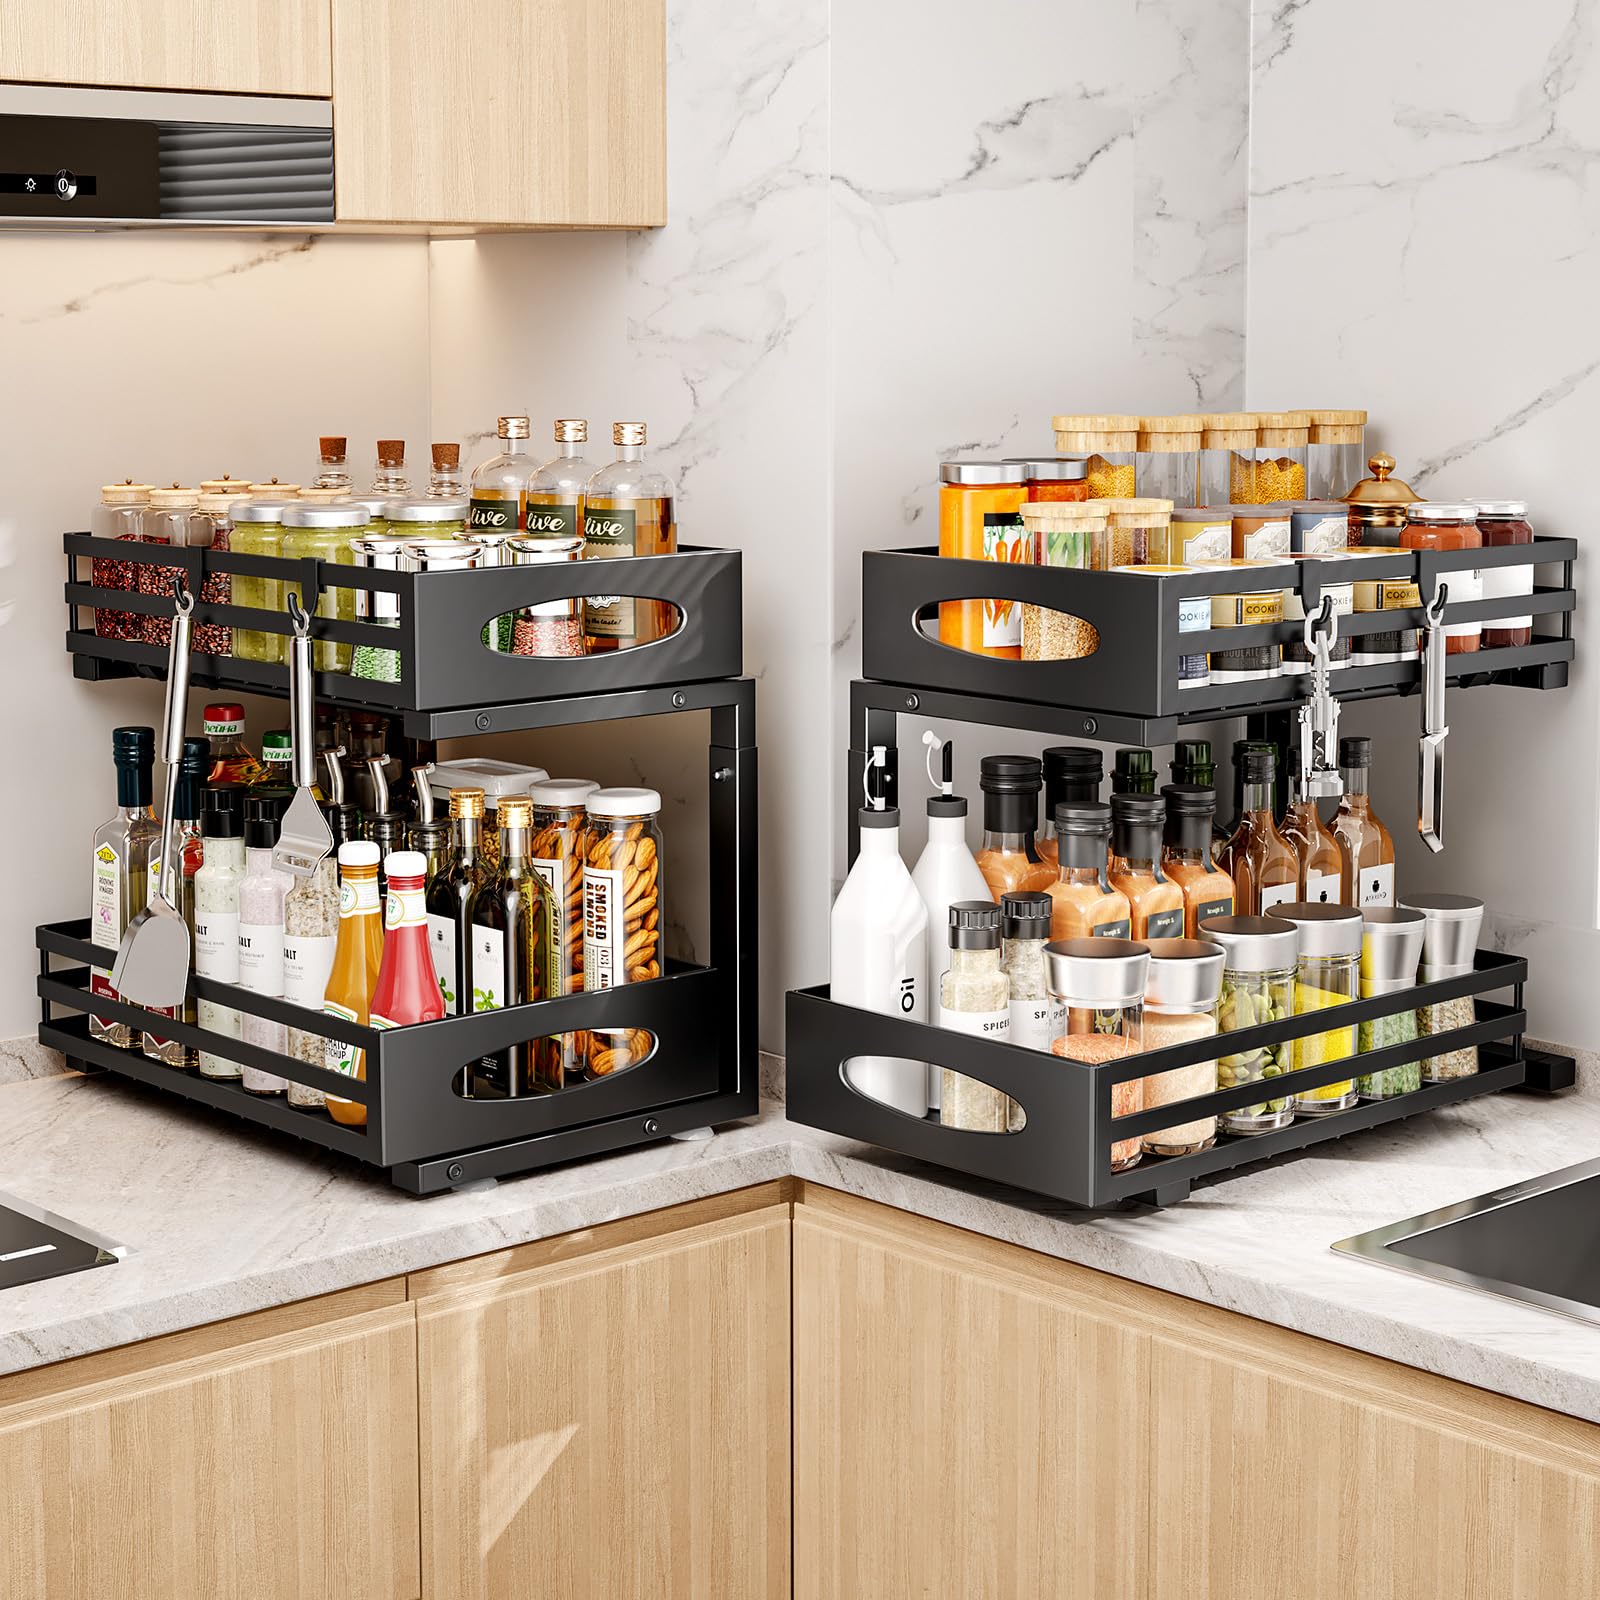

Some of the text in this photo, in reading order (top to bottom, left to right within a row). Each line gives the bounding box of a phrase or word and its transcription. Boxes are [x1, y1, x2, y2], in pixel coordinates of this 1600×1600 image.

[1179, 612, 1205, 622] OOKIE
[585, 881, 595, 938] ALMOND
[594, 884, 607, 940] SMOKED
[900, 977, 915, 1013] Oil
